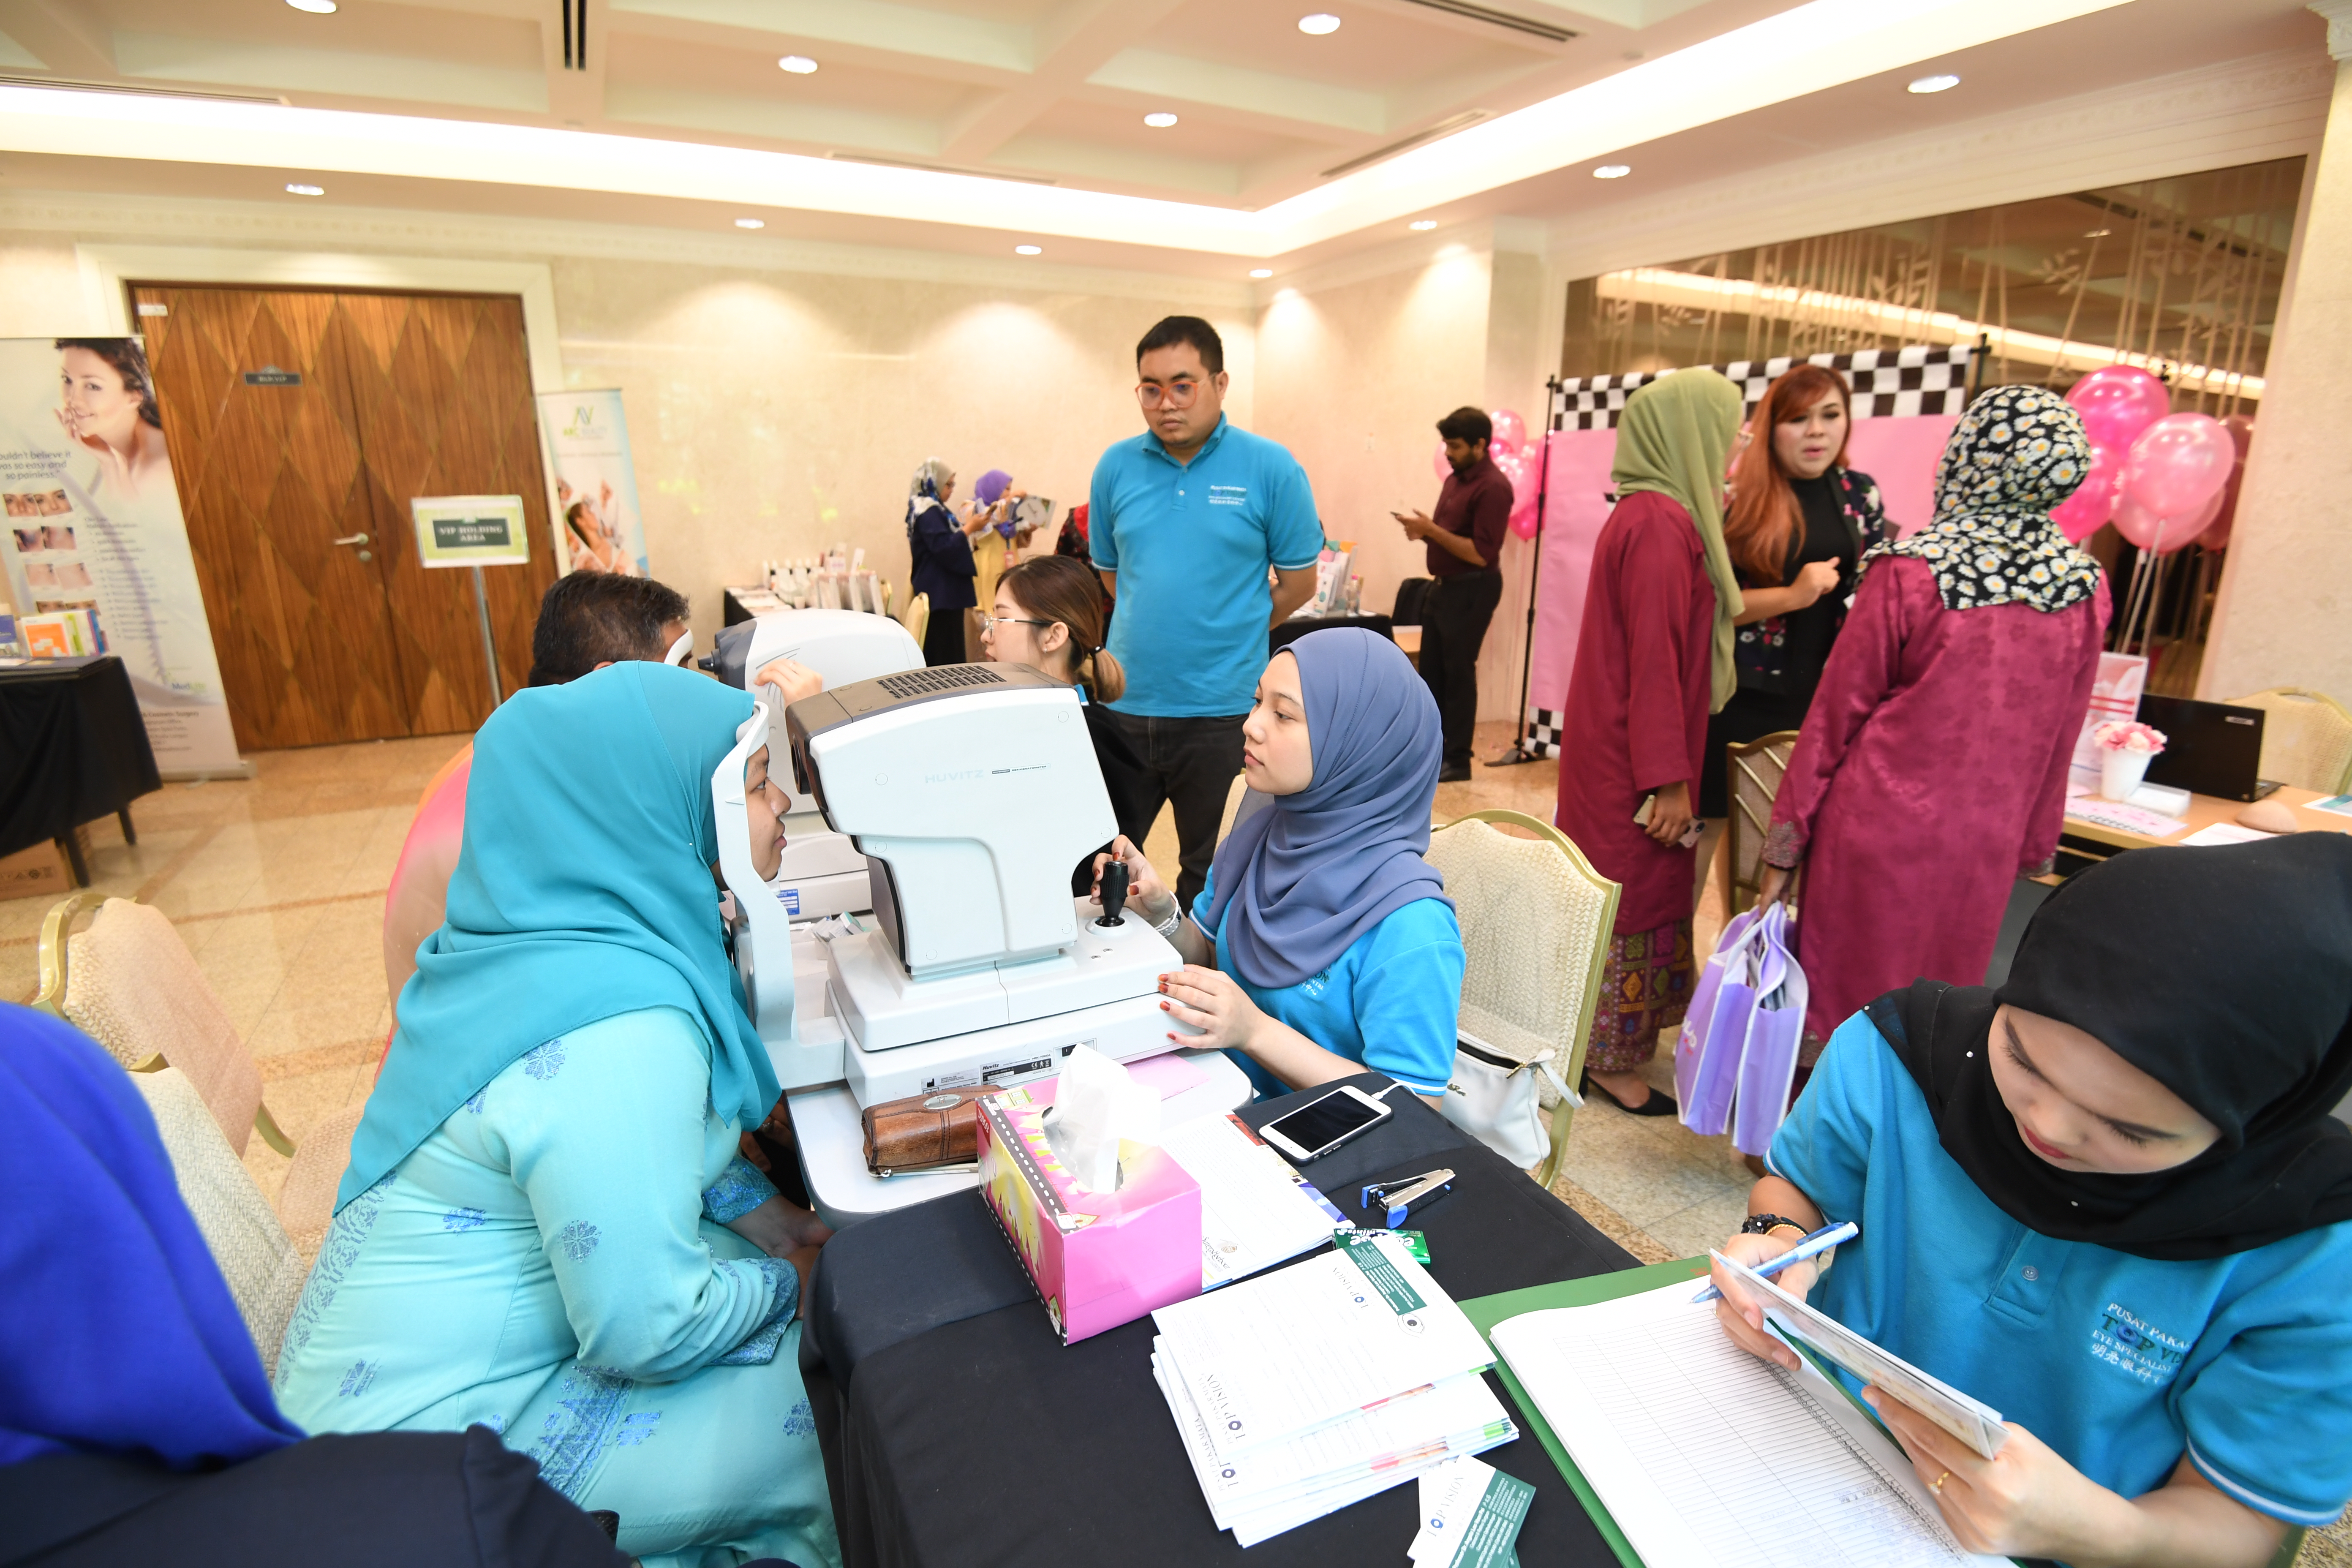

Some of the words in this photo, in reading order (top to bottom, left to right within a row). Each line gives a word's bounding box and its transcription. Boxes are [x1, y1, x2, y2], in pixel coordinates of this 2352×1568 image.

[0, 451, 28, 460] ouldn't
[440, 527, 456, 535] VIP
[459, 525, 503, 534] HOLDING
[925, 770, 984, 783] HUVITZ
[982, 1063, 999, 1071] Huvitz
[1332, 1266, 1352, 1290] VISION
[1350, 1291, 1369, 1308] TOP
[2107, 1302, 2148, 1331] PUSAT
[2102, 1312, 2156, 1351] TOP
[2092, 1329, 2114, 1345] EYE
[2114, 1342, 2171, 1372] SPECIALIST
[1197, 1377, 1209, 1395] MATA
[1206, 1373, 1228, 1408] VISION
[1206, 1397, 1222, 1419] PAKAR
[1193, 1418, 1206, 1439] MATA
[1219, 1422, 1233, 1443] PUSAT
[1220, 1407, 1247, 1443] TOP
[1200, 1441, 1217, 1467] PAKAR
[1211, 1469, 1225, 1491] PUSAT
[1426, 1509, 1446, 1537] TOP
[1440, 1477, 1465, 1507] VISION
